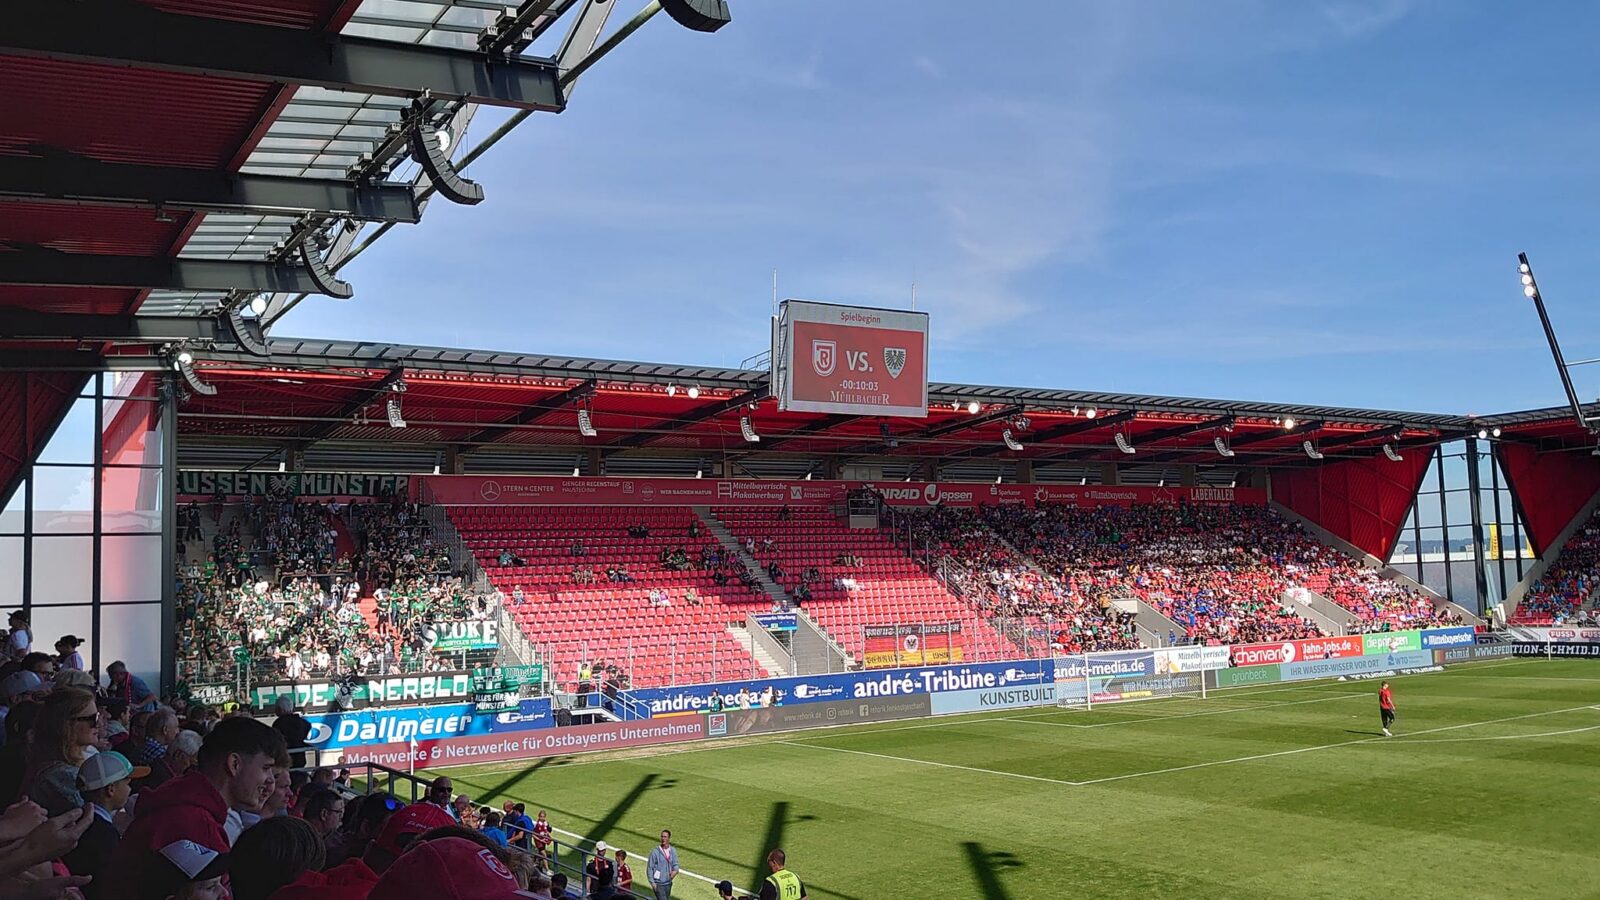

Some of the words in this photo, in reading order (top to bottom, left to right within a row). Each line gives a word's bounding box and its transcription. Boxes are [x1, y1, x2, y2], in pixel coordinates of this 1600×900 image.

[841, 312, 880, 324] Spielbeginn
[846, 350, 873, 372] VS.
[840, 380, 879, 391] -00:10:03
[301, 473, 409, 495] MÜNSTER
[733, 482, 787, 491] Mittelbayerische
[732, 492, 784, 501] Plakatwerbung
[1091, 491, 1137, 501] Mittelbayerische
[1191, 488, 1235, 501] LABERTALER
[1303, 639, 1352, 654] Jahn-Jobs.de
[1429, 632, 1473, 646] Mittelbayerische
[1474, 643, 1600, 658] WWW.SPEDITION-SCHMID.D
[1290, 667, 1302, 676] IHR
[1303, 662, 1353, 675] WASSER-WISSER
[1354, 661, 1367, 670] VOR
[1368, 659, 1380, 668] ORT
[854, 669, 996, 698] andré-Tribüne
[980, 688, 1055, 706] KUNSTBUILT
[338, 715, 472, 742] Dallmeier
[347, 749, 427, 764] Mehrwerte
[430, 748, 442, 759] &
[446, 737, 519, 758] Netzwerke
[522, 735, 542, 750] für
[546, 732, 617, 748] Ostbayerns
[620, 723, 701, 740] Unternehmen
